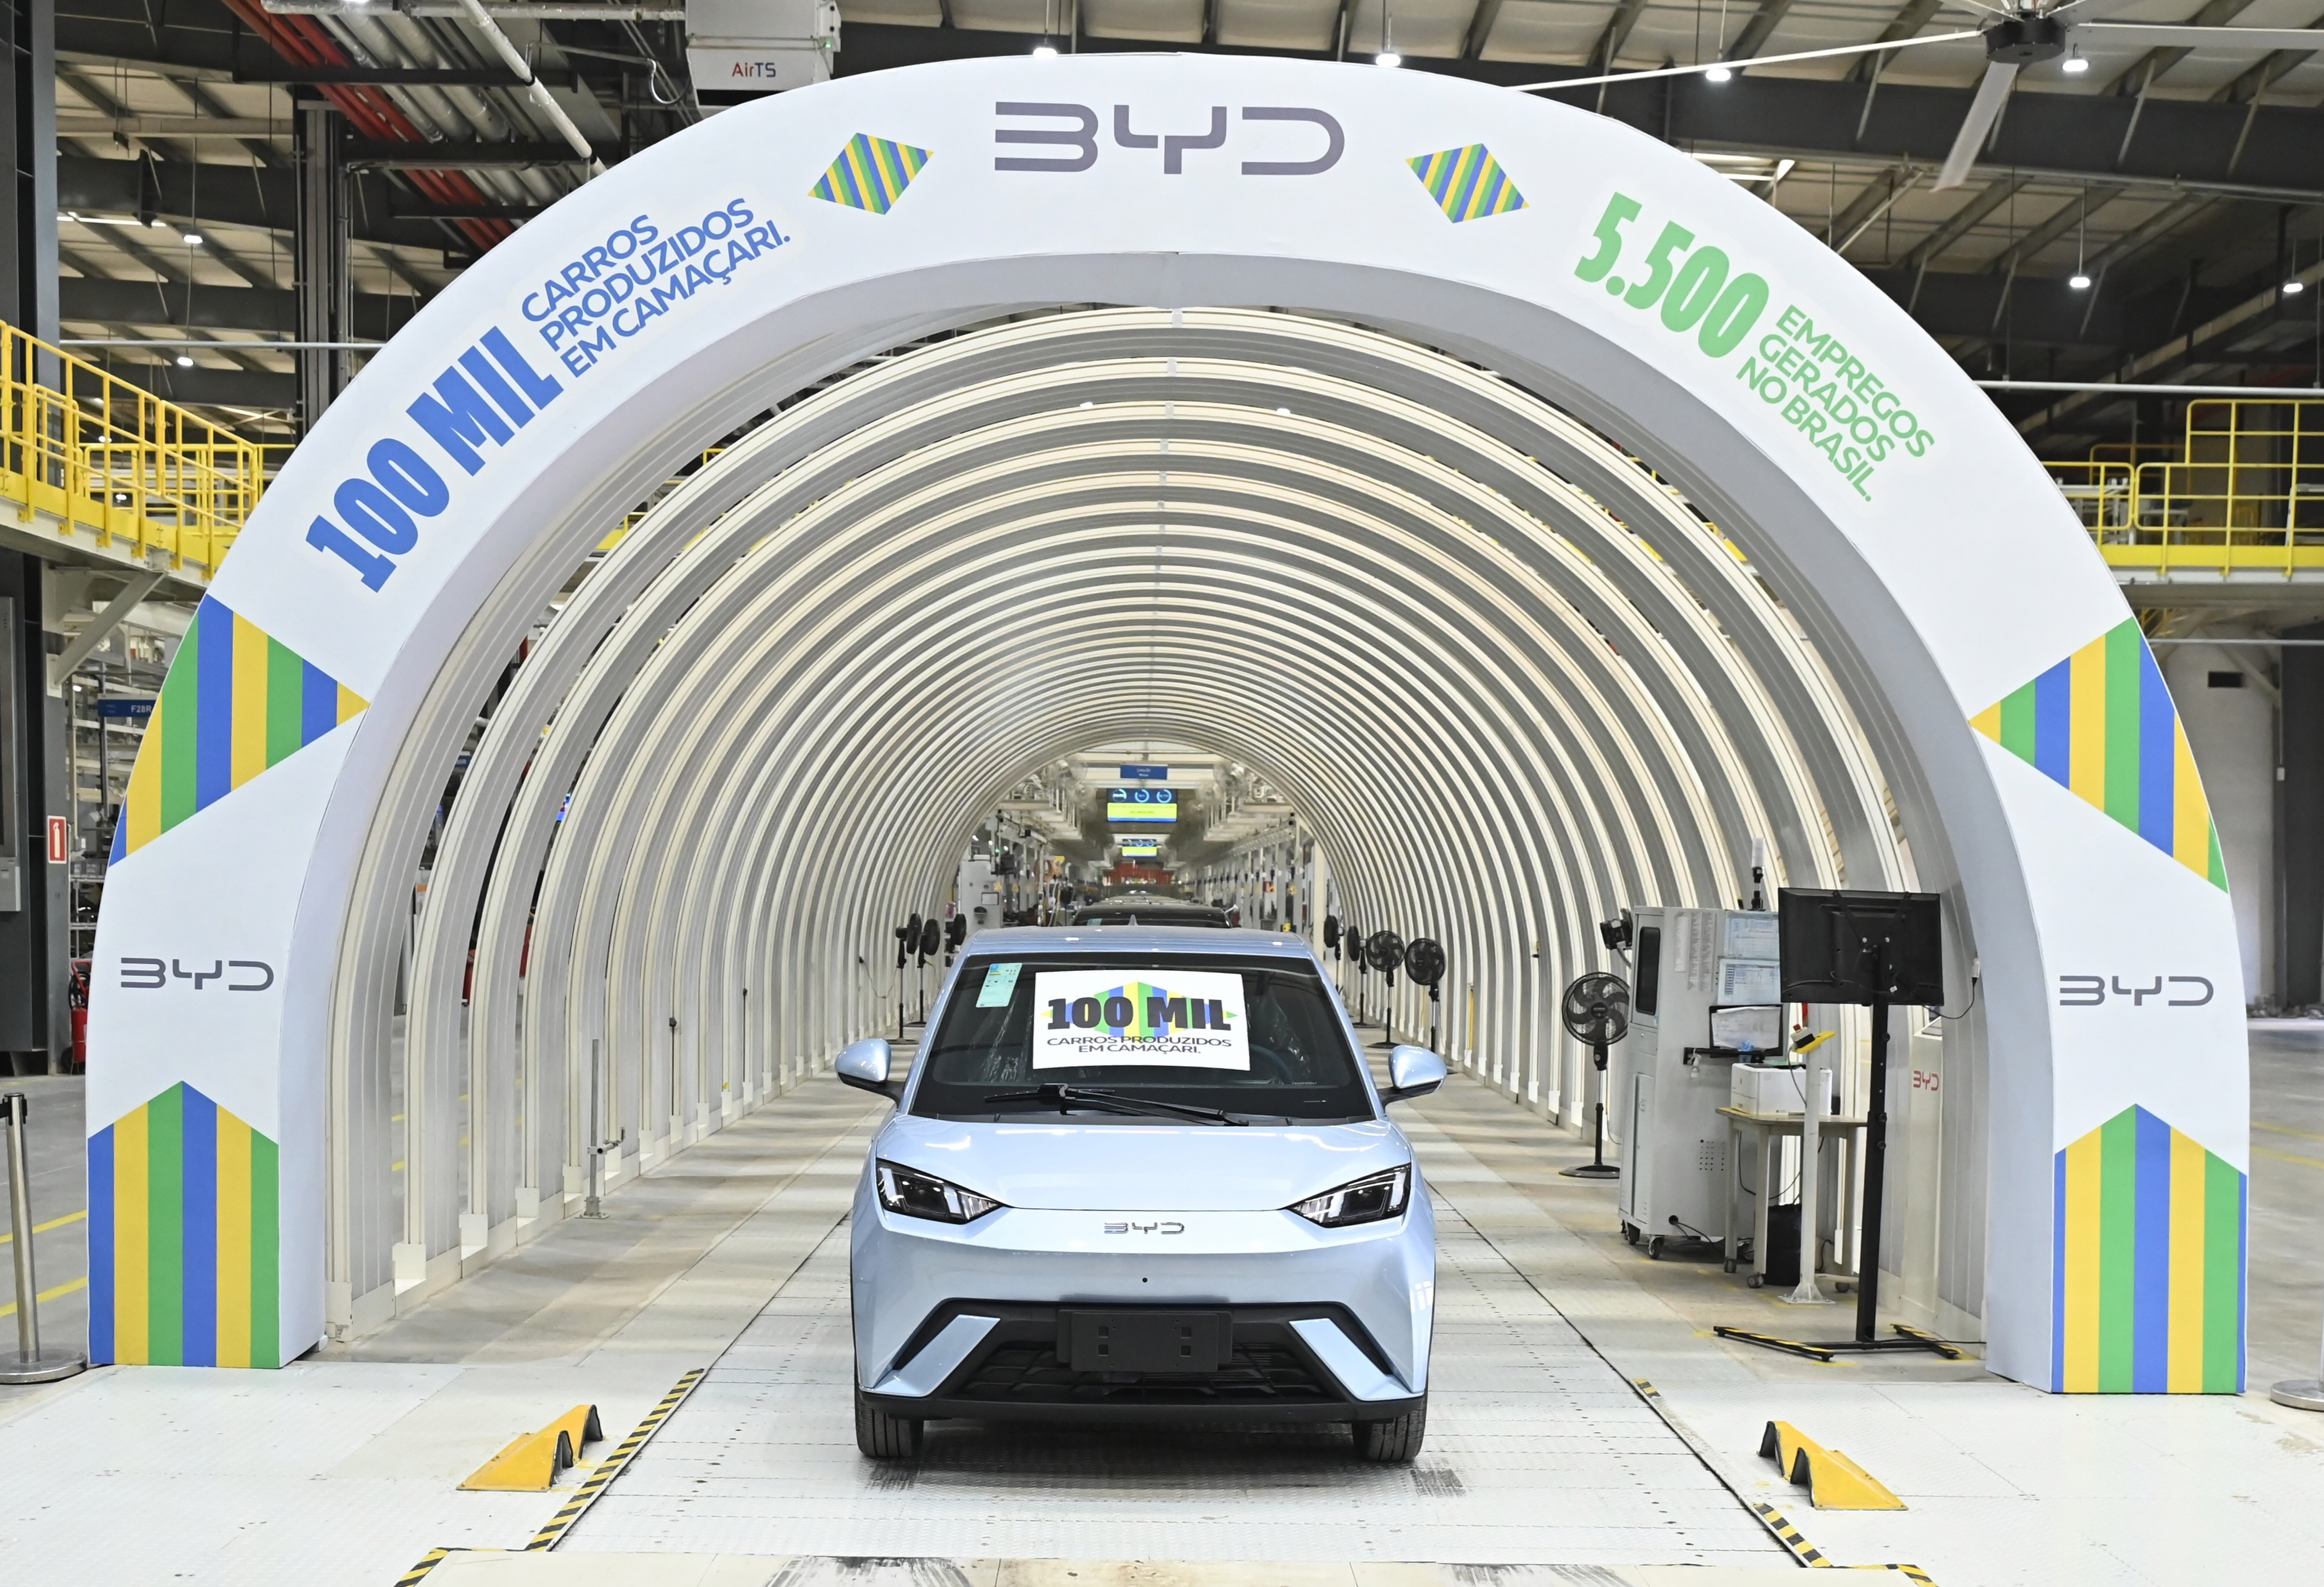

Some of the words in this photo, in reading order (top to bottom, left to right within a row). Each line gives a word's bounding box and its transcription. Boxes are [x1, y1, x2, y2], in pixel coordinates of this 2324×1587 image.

[732, 62, 776, 78] AirTS
[994, 101, 1346, 175] BYD
[521, 214, 659, 322] CARROS
[539, 198, 755, 352] PRODUZIDOS
[560, 326, 617, 378] EM
[612, 220, 791, 338] CAMAÇARI.
[1574, 192, 1770, 359] 5.500
[1759, 333, 1895, 462] GERADOS
[1776, 305, 1935, 458] EMPREGOS
[305, 437, 451, 593] 100
[406, 326, 565, 477] MIL
[1736, 356, 1788, 405] NO
[1781, 394, 1873, 502] BRASIL.
[120, 957, 275, 991] BYD
[2059, 975, 2214, 1006] BYD
[1047, 996, 1133, 1029] 100
[1147, 996, 1231, 1031] MIL
[1047, 1037, 1117, 1045] CARROS
[1120, 1036, 1232, 1046] PRODUZIDOS
[1107, 1044, 1201, 1054] CAMAÇARI.
[1913, 1070, 1939, 1091] BYD
[1104, 1221, 1185, 1235] BYD
